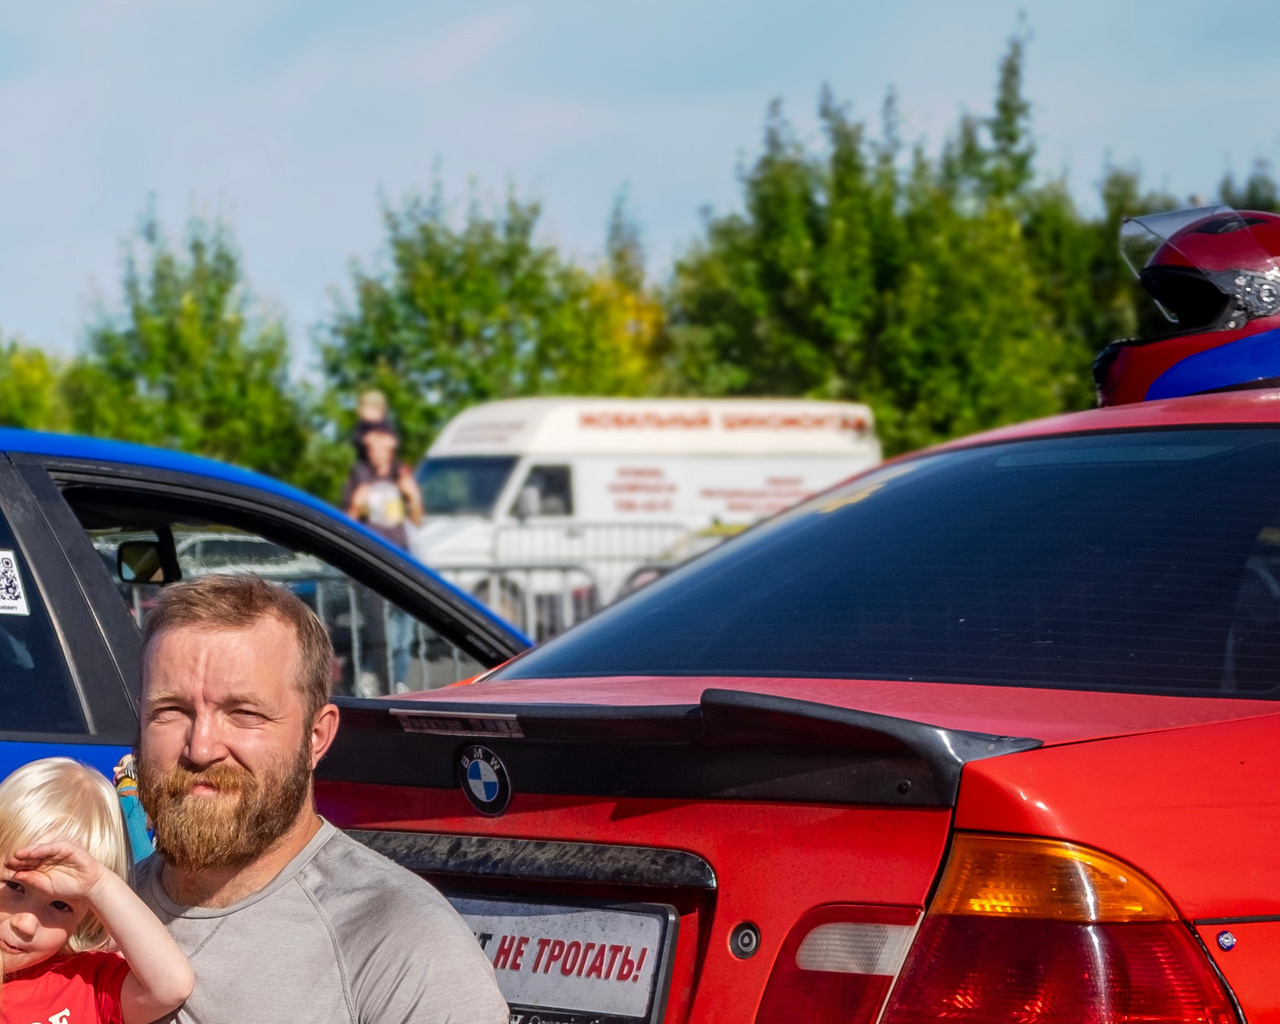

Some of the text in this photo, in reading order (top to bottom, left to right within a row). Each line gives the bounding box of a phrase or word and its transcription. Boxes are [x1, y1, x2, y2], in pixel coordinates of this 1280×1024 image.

[461, 748, 501, 771] BMW
[494, 935, 529, 970] НЕ
[532, 938, 648, 982] ТРОГАТЬ!
